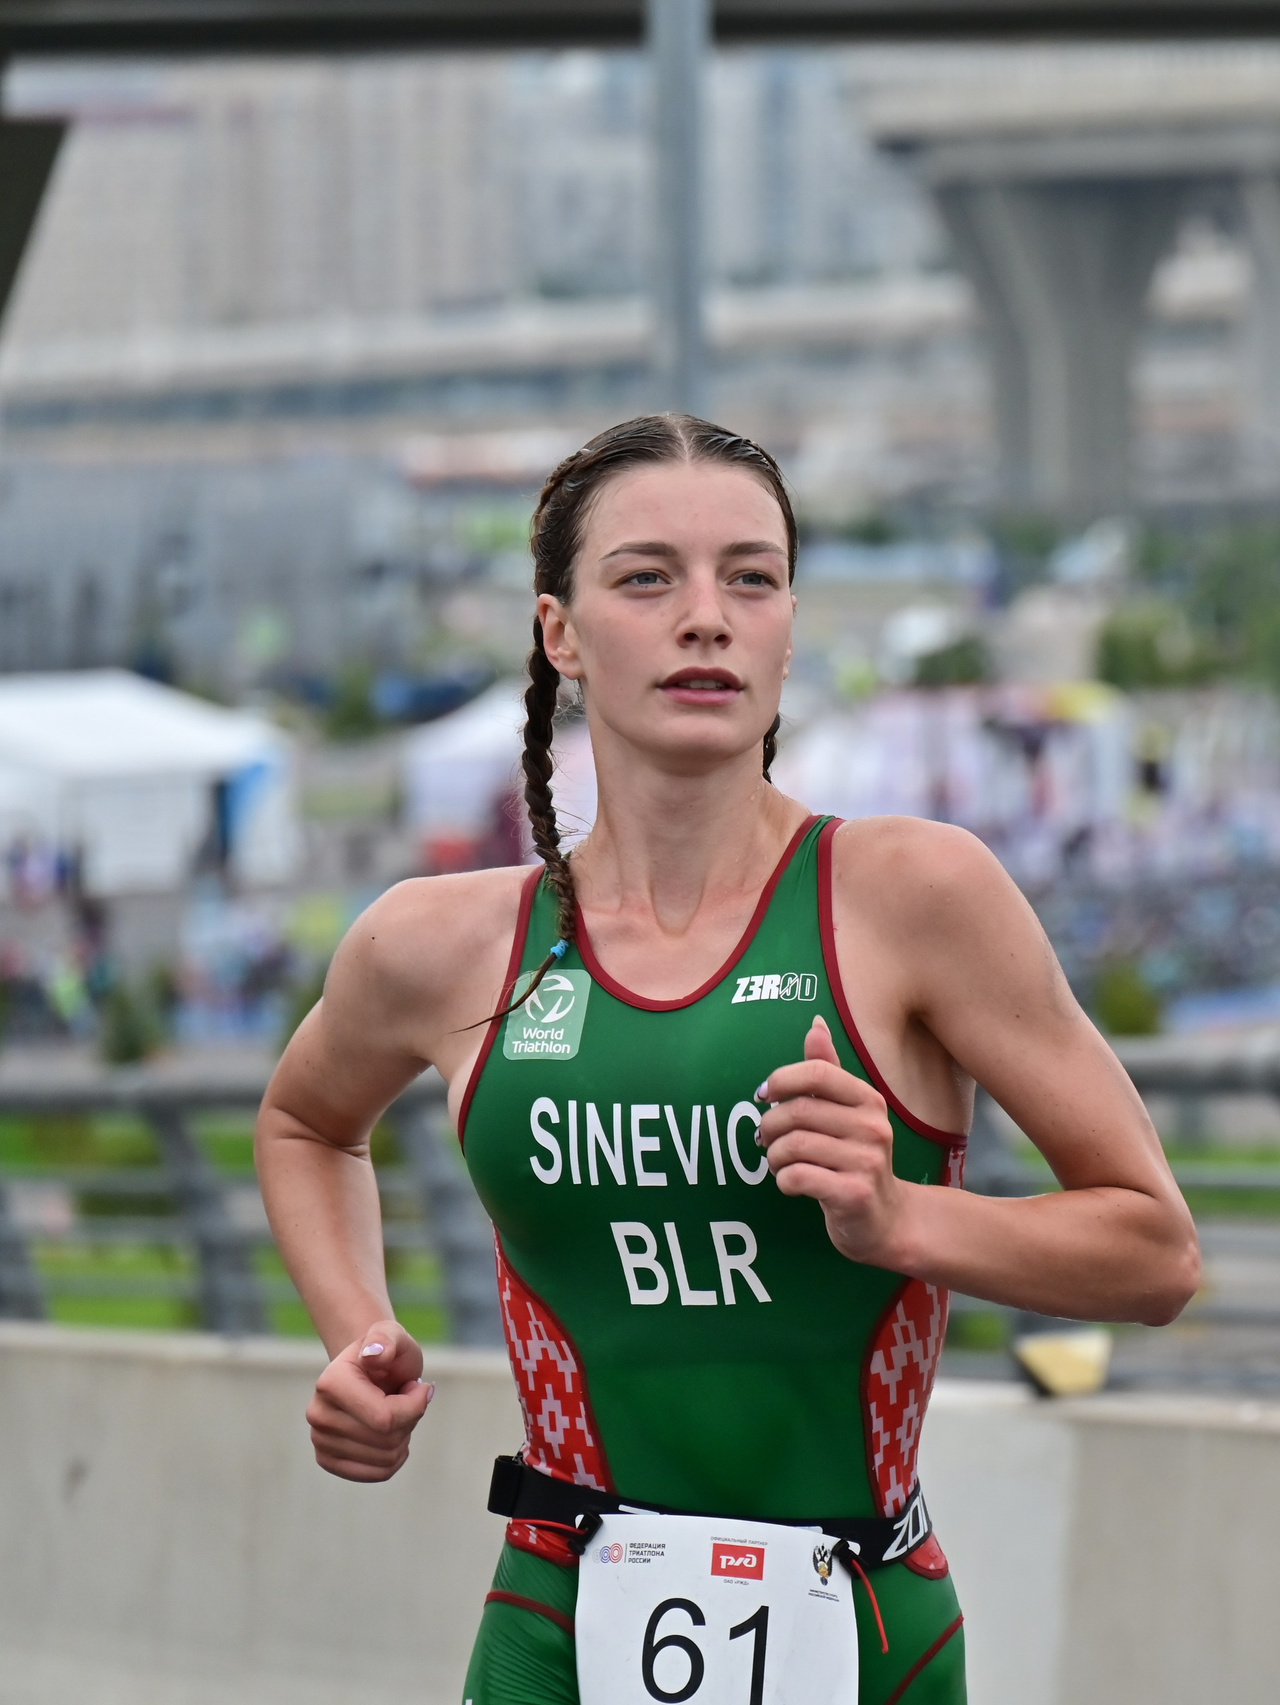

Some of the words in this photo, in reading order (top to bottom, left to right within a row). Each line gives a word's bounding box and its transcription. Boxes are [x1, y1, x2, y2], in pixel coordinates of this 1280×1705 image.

[512, 1041, 570, 1054] Triathlon
[523, 1027, 564, 1040] World
[529, 1097, 779, 1187] SINEVIC
[610, 1221, 772, 1306] BLR
[641, 1597, 769, 1705] 61
